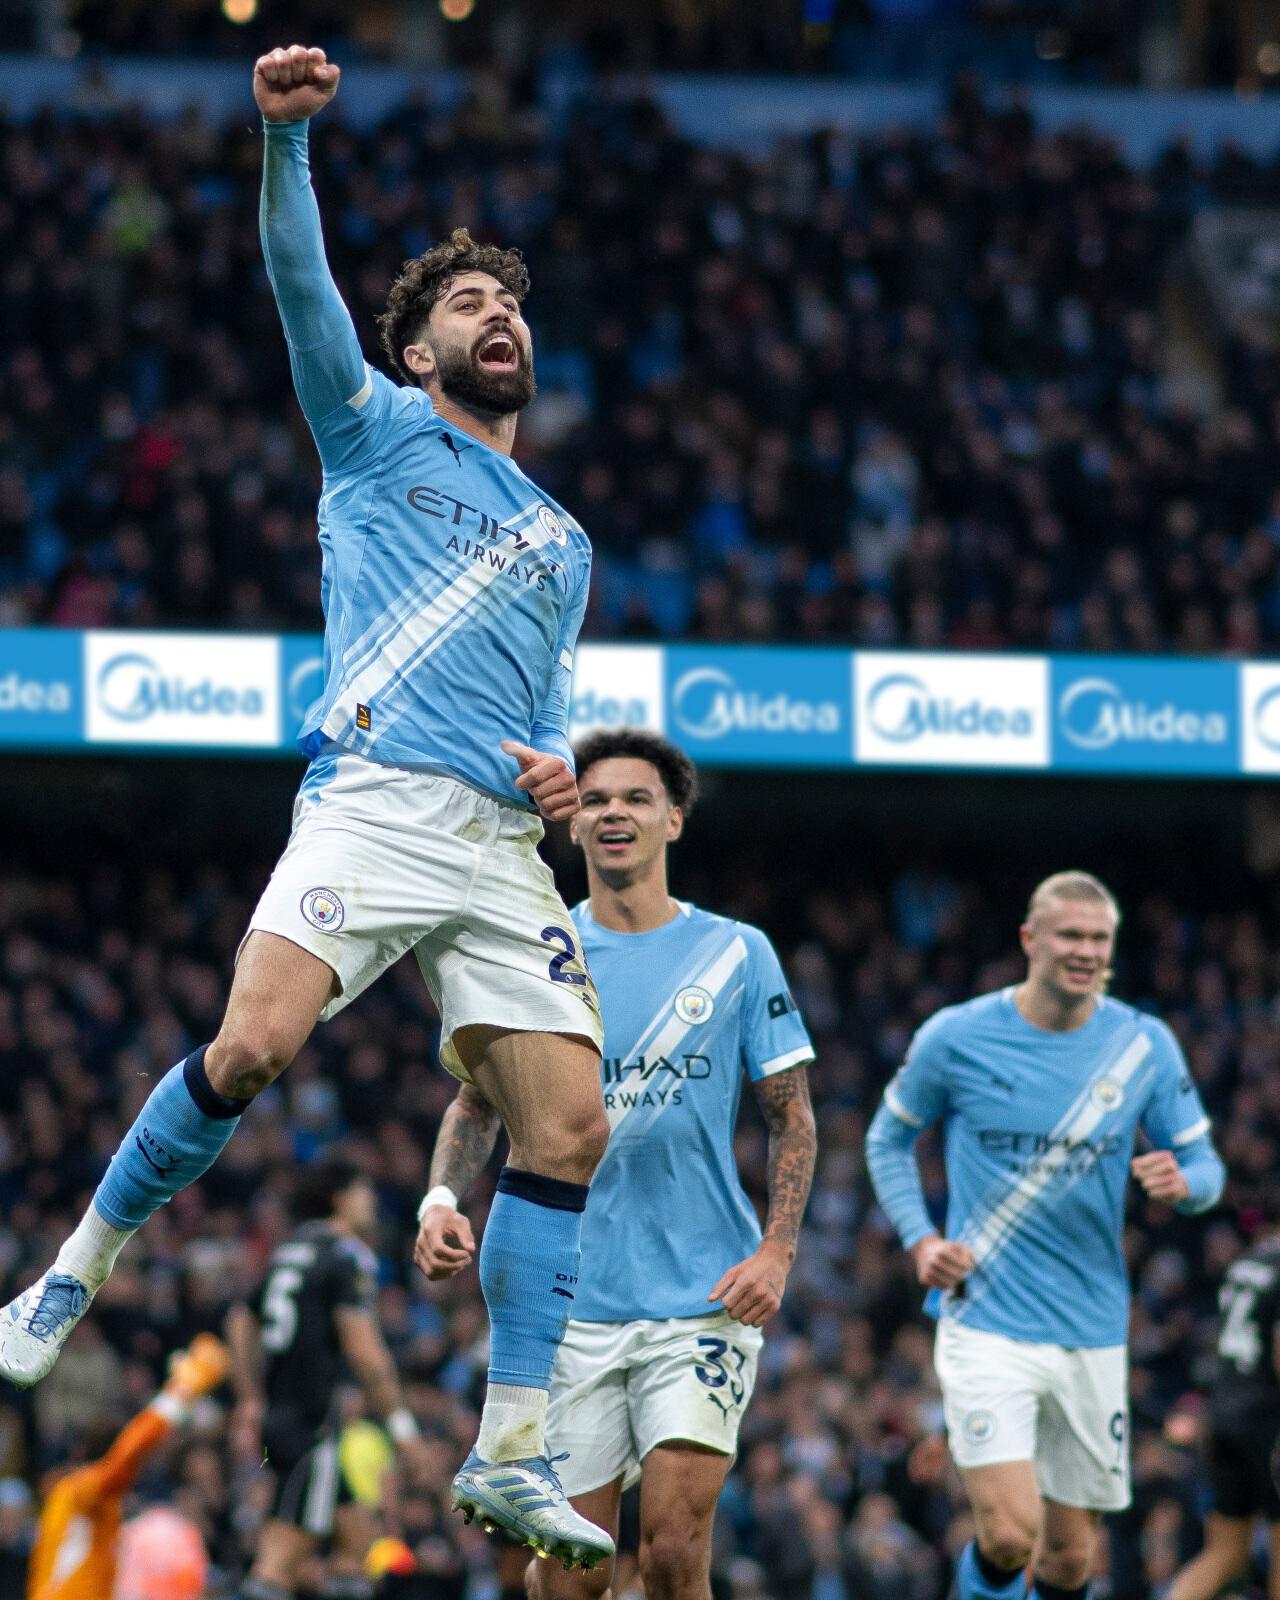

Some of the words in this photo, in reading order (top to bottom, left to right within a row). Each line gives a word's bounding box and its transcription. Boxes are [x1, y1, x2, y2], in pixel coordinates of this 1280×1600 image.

[446, 535, 547, 592] AIRWAYS
[130, 673, 265, 717] Midea
[573, 690, 646, 728] dea
[704, 689, 839, 733] Midea
[898, 694, 1034, 738] Midea
[1092, 699, 1227, 744] Midea
[604, 1054, 711, 1083] IHAD
[604, 1089, 683, 1109] RWAYS
[263, 1267, 302, 1350] 5
[695, 1337, 746, 1405] 33
